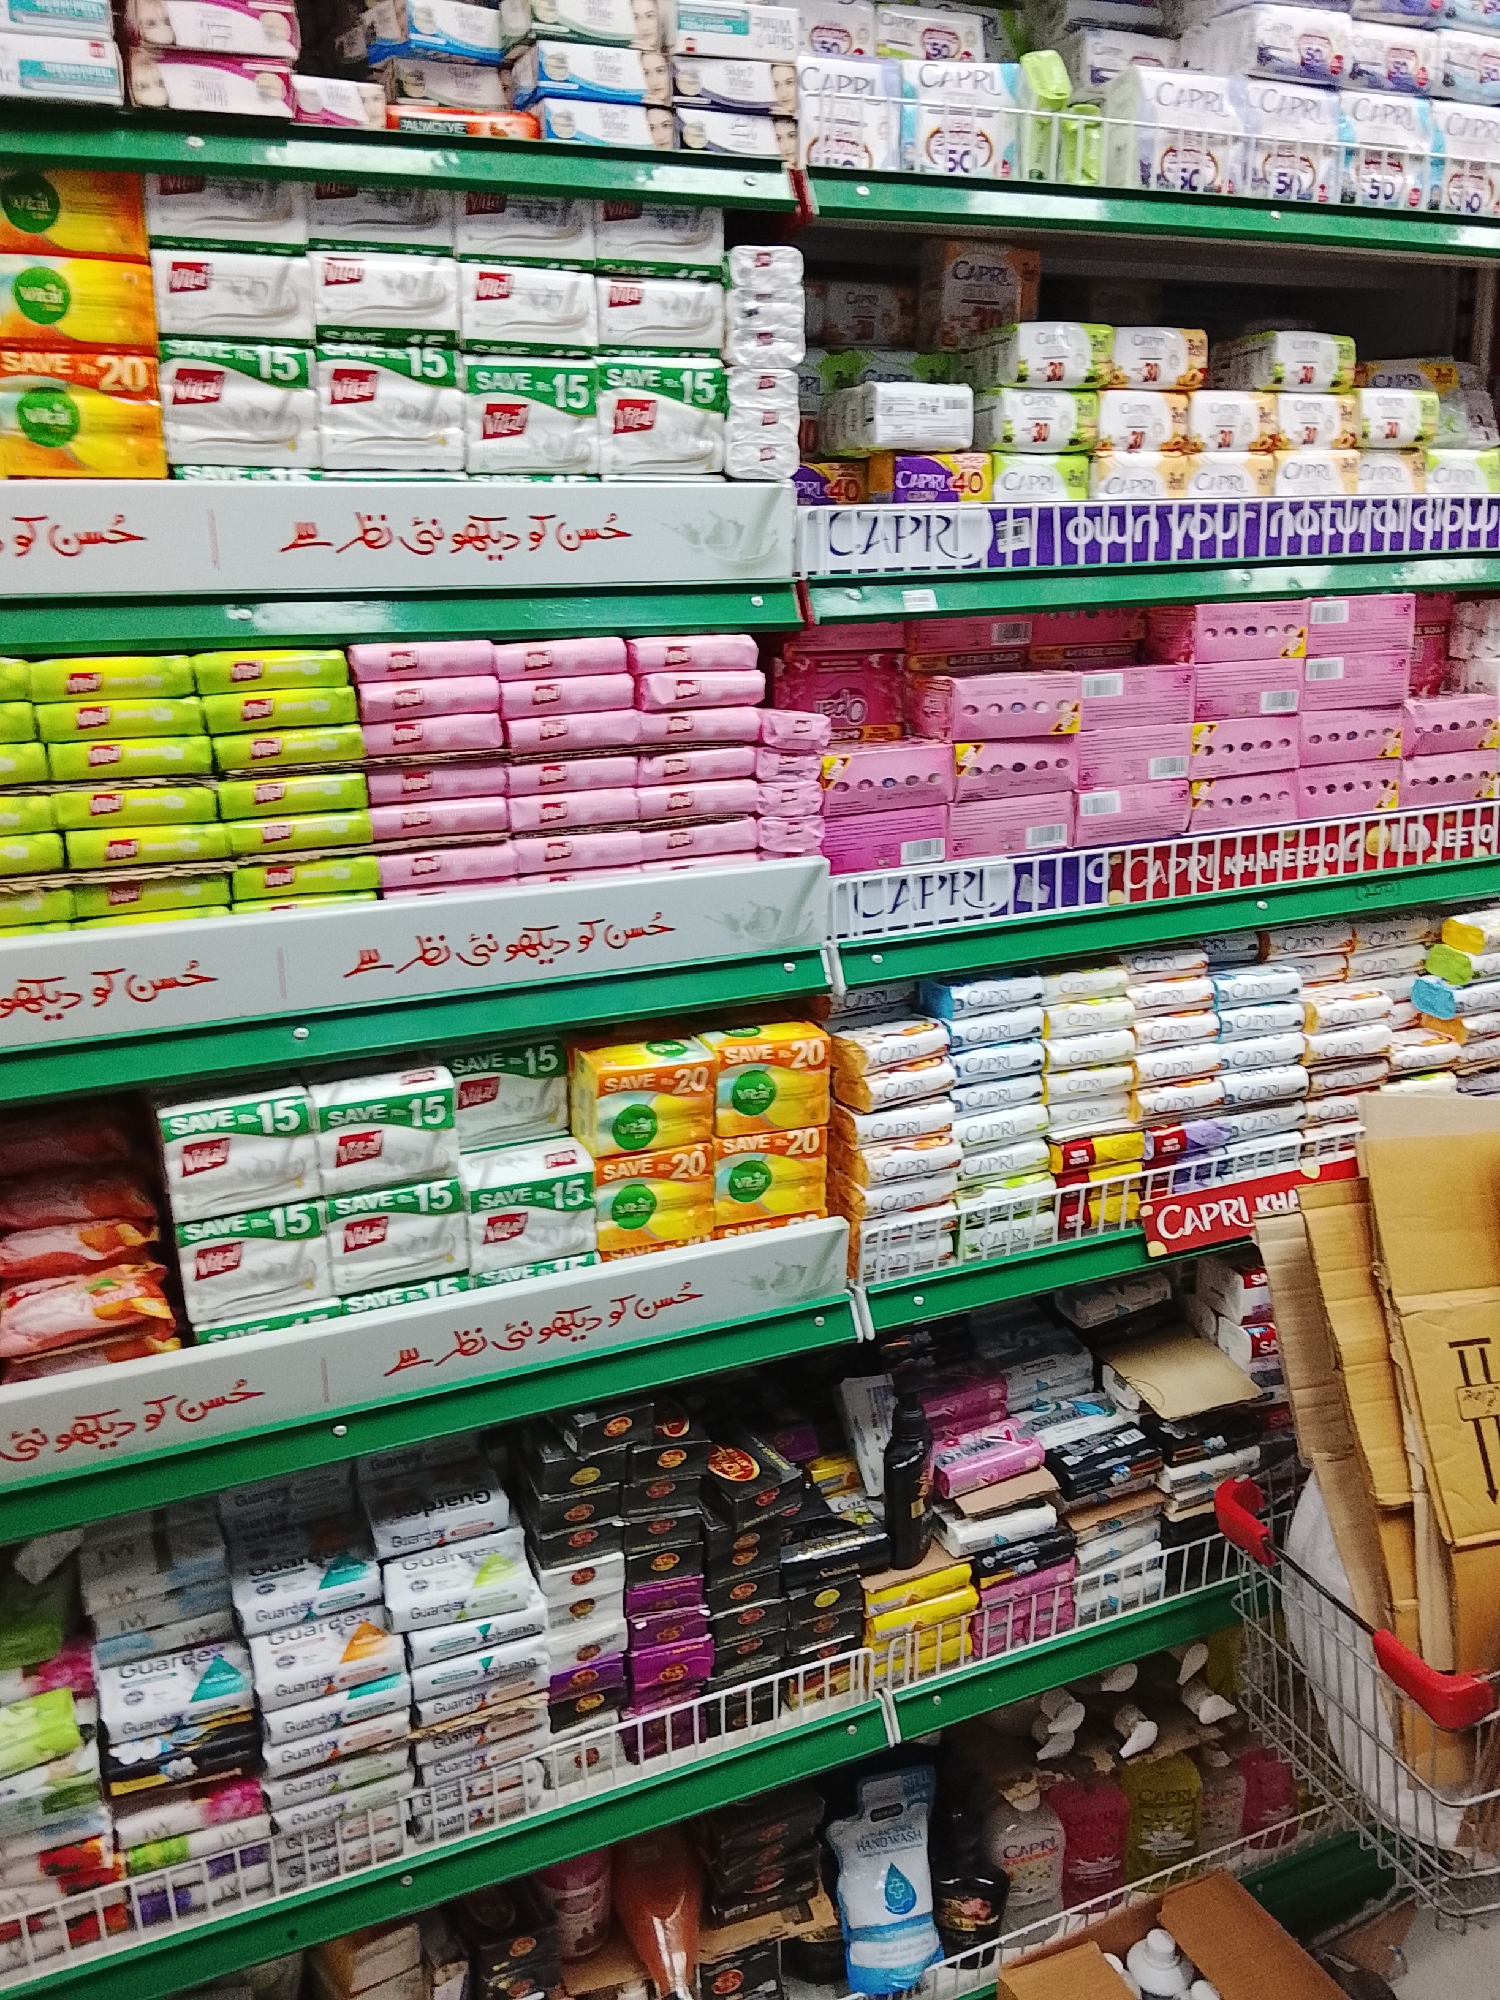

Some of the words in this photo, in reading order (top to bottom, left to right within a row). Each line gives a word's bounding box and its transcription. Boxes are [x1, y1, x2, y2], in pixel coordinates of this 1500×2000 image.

[800, 65, 882, 104] CAPRI
[918, 63, 1001, 96] CAPRI
[1156, 81, 1229, 118] CAPRI
[1260, 88, 1322, 124] CAPRI
[1351, 98, 1417, 131] CAPRI
[951, 260, 1014, 287] CAPRI
[2, 351, 72, 375] SAVE
[96, 356, 148, 391] 20
[257, 349, 303, 381] 15
[406, 348, 448, 377] 15
[475, 370, 533, 392] SAVE
[552, 374, 591, 407] 15
[605, 368, 662, 389] SAVE
[680, 370, 716, 404] 15
[895, 470, 952, 492] CAPRI
[1001, 471, 1058, 494] CAPRI
[829, 509, 975, 559] CAPRI
[1065, 513, 1160, 545] own
[1168, 511, 1258, 550] your
[1269, 500, 1407, 539] natural
[1126, 853, 1221, 889] CAPRI
[1223, 842, 1340, 876] KHAREEDO
[1342, 821, 1432, 863] GOLD
[853, 867, 997, 918] CAPRI
[966, 988, 1013, 1007] CAPRI
[1232, 982, 1273, 998] CAPRI
[965, 1024, 1014, 1043] CAPRI
[1151, 1022, 1194, 1041] CAPRI
[1235, 1014, 1277, 1030] CAPRI
[451, 1053, 506, 1076] SAVE
[525, 1045, 560, 1075] 15
[724, 1043, 776, 1065] SAVE
[790, 1039, 826, 1070] 20
[878, 1044, 922, 1065] CAPRI
[964, 1054, 1012, 1073] CAPRI
[604, 1072, 657, 1094] SAVE
[672, 1066, 710, 1095] 20
[1153, 1060, 1194, 1078] CAPRI
[883, 1078, 928, 1100] CAPRI
[965, 1088, 1014, 1109] CAPRI
[170, 1108, 236, 1136] SAVE
[257, 1099, 301, 1134] 15
[327, 1102, 388, 1126] SAVE
[409, 1095, 447, 1127] 15
[1153, 1095, 1196, 1112] CAPRI
[722, 1133, 772, 1154] SAVE
[785, 1127, 821, 1155] 20
[870, 1119, 924, 1140] CAPRI
[965, 1120, 1019, 1144] CAPRI
[604, 1158, 655, 1181] SAVE
[670, 1151, 708, 1180] 20
[882, 1158, 933, 1179] CAPRI
[963, 1153, 1018, 1176] CAPRI
[334, 1193, 395, 1216] SAVE
[414, 1180, 453, 1212] 15
[478, 1187, 533, 1211] SAVE
[551, 1178, 587, 1210] 15
[880, 1191, 927, 1212] CAPRI
[183, 1212, 248, 1241] SAVE
[269, 1202, 313, 1237] 15
[1157, 1196, 1256, 1241] CAPRI
[256, 1599, 315, 1623] Guardex
[410, 1600, 467, 1621] Guardex
[268, 1608, 370, 1646] Guardex
[120, 1644, 226, 1679] Guardex
[274, 1674, 335, 1697] Guardex
[122, 1711, 185, 1735] Guardex
[281, 1738, 340, 1763] Guardex
[1003, 1836, 1056, 1860] CAPRI
